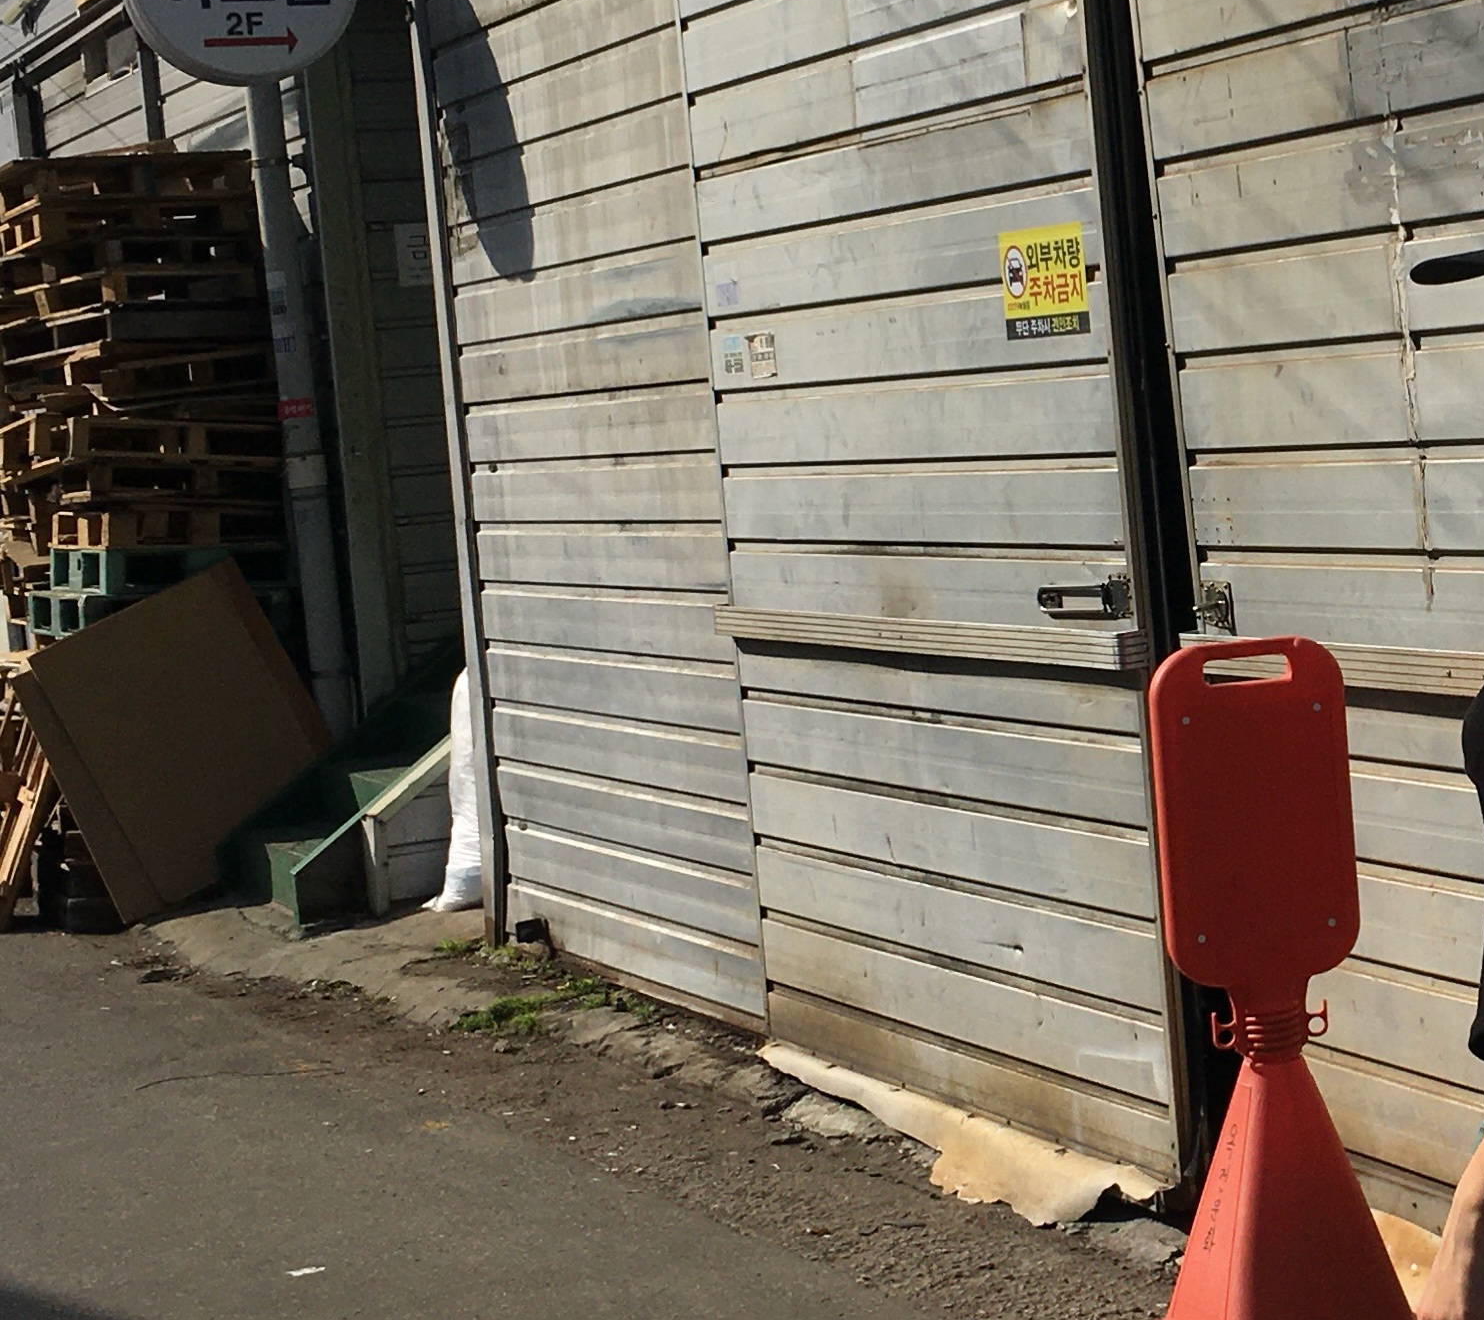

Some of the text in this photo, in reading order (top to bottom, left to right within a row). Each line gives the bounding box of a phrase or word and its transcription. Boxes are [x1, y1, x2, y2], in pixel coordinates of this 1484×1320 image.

[225, 12, 263, 35] 2F
[1026, 237, 1081, 272] 외부차량
[1029, 270, 1083, 307] 주차금지
[1015, 320, 1030, 336] 무단
